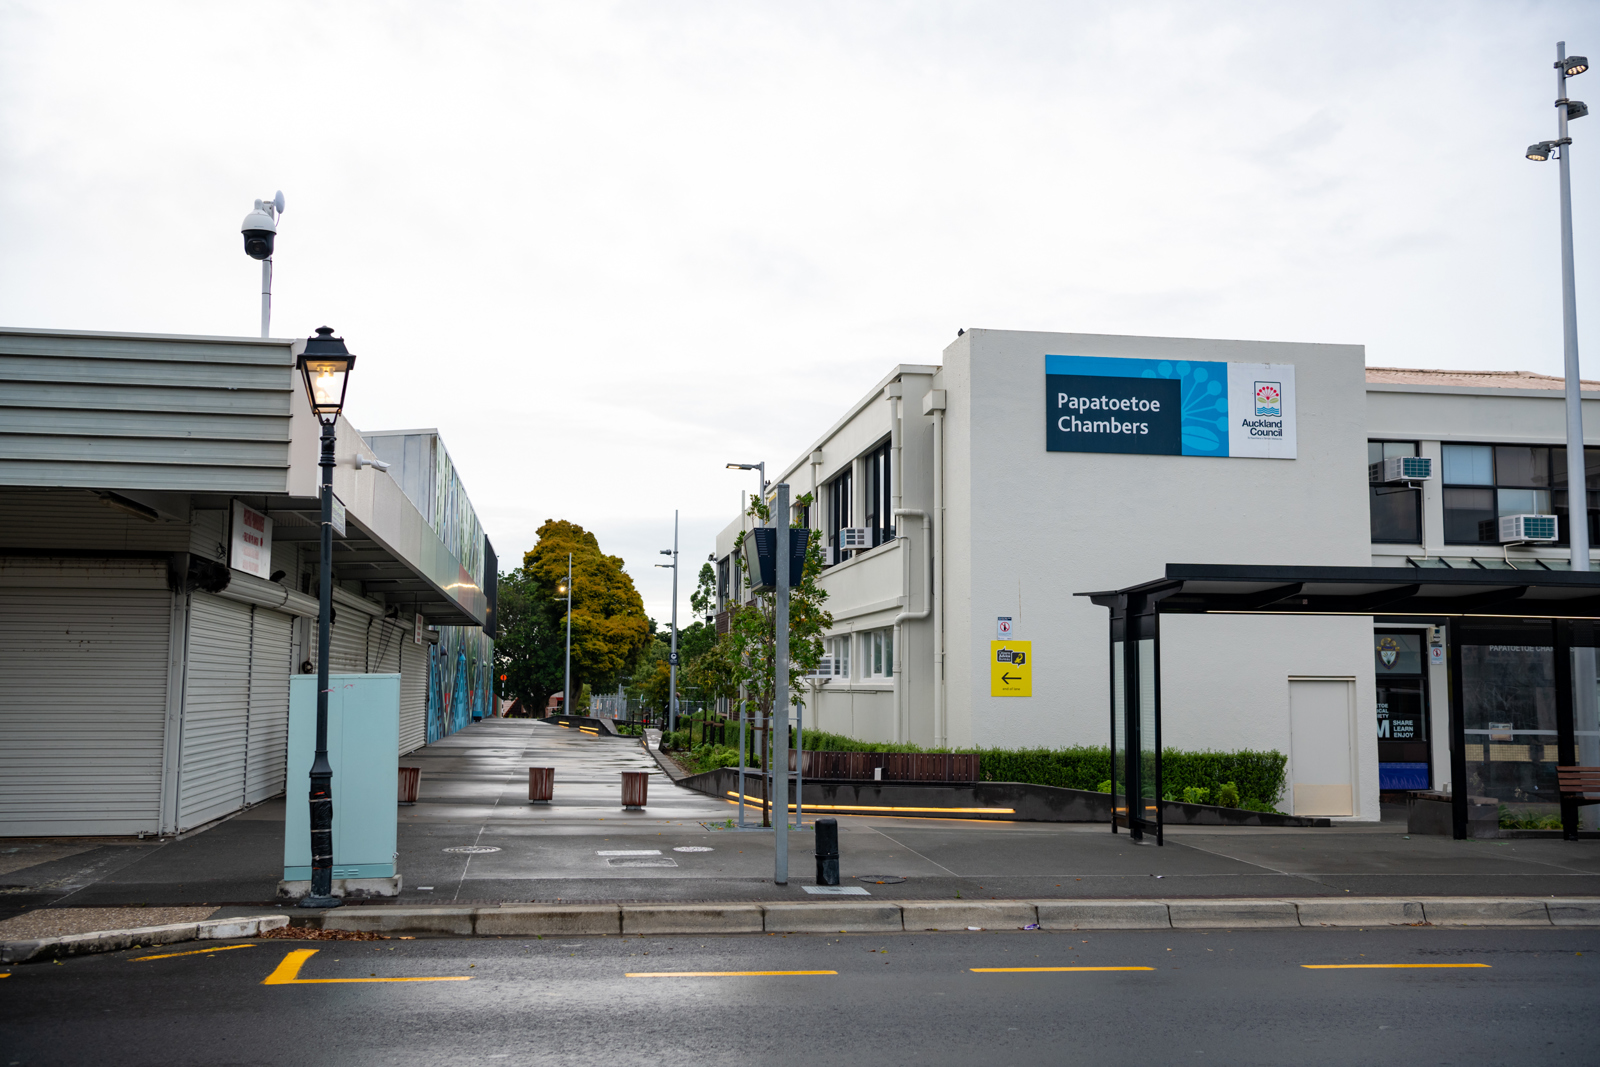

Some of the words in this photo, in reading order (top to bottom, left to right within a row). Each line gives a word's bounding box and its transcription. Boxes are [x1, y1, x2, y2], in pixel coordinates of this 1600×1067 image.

[1058, 393, 1160, 414] Papatoetoe
[1058, 415, 1149, 435] Chambers
[1242, 418, 1282, 428] Auckland
[1250, 427, 1282, 437] Council
